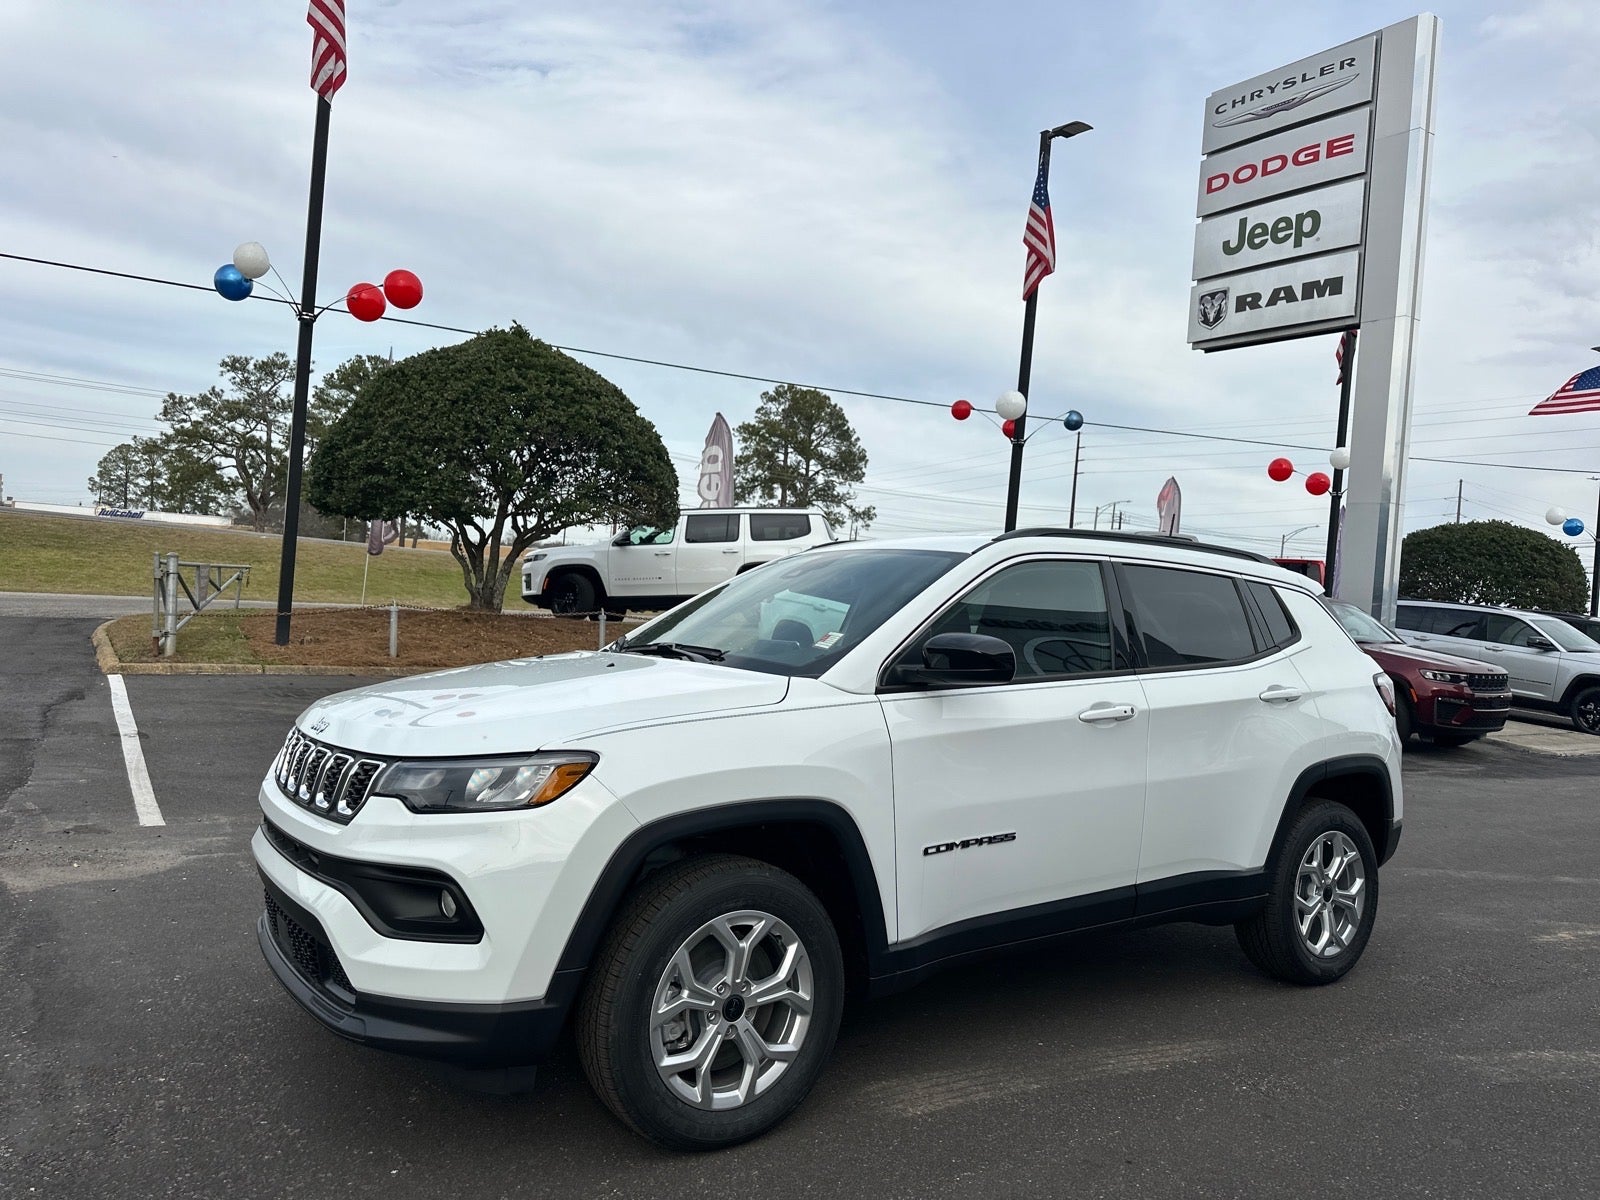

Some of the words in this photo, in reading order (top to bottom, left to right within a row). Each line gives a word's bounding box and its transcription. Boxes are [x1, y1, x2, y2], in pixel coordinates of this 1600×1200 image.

[1214, 56, 1357, 116] CHRYSLER
[1206, 133, 1356, 195] DODGE
[1222, 209, 1321, 256] Jeep
[1234, 275, 1344, 314] RAM
[922, 832, 1017, 857] COMPASS
